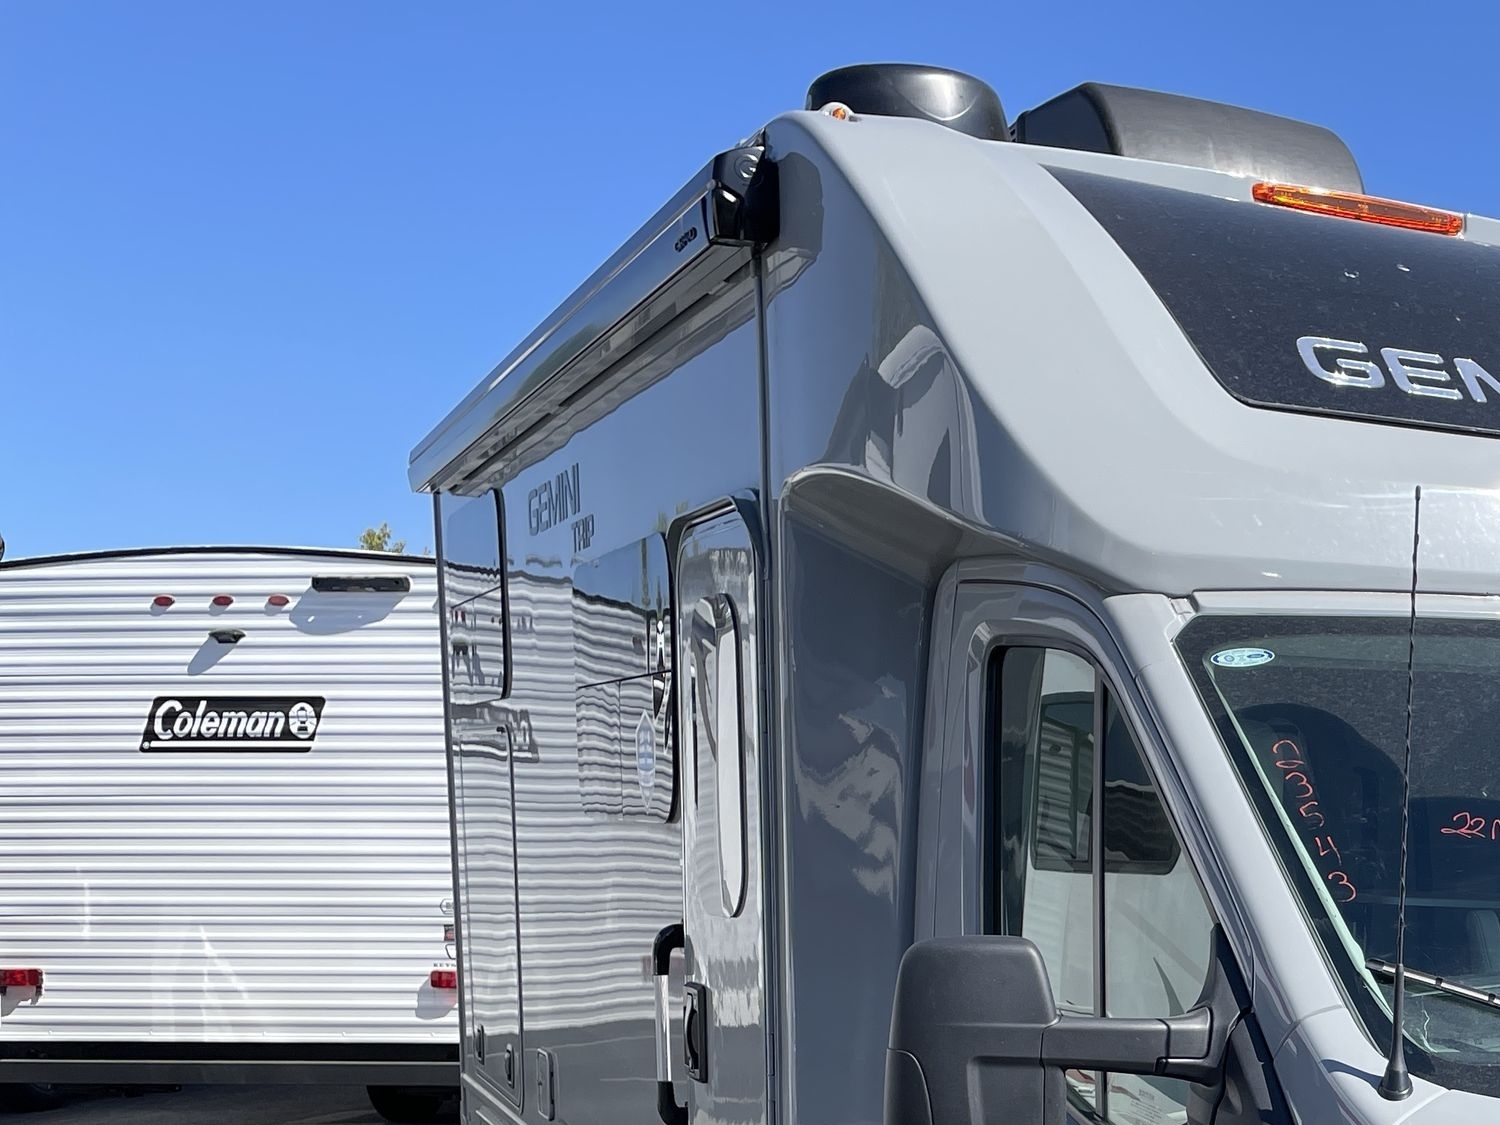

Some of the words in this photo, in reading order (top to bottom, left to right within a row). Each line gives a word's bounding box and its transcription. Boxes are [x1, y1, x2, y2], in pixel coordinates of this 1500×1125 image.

[528, 462, 581, 536] GEMINI
[571, 513, 595, 553] TRIP
[153, 699, 286, 740] Coleman
